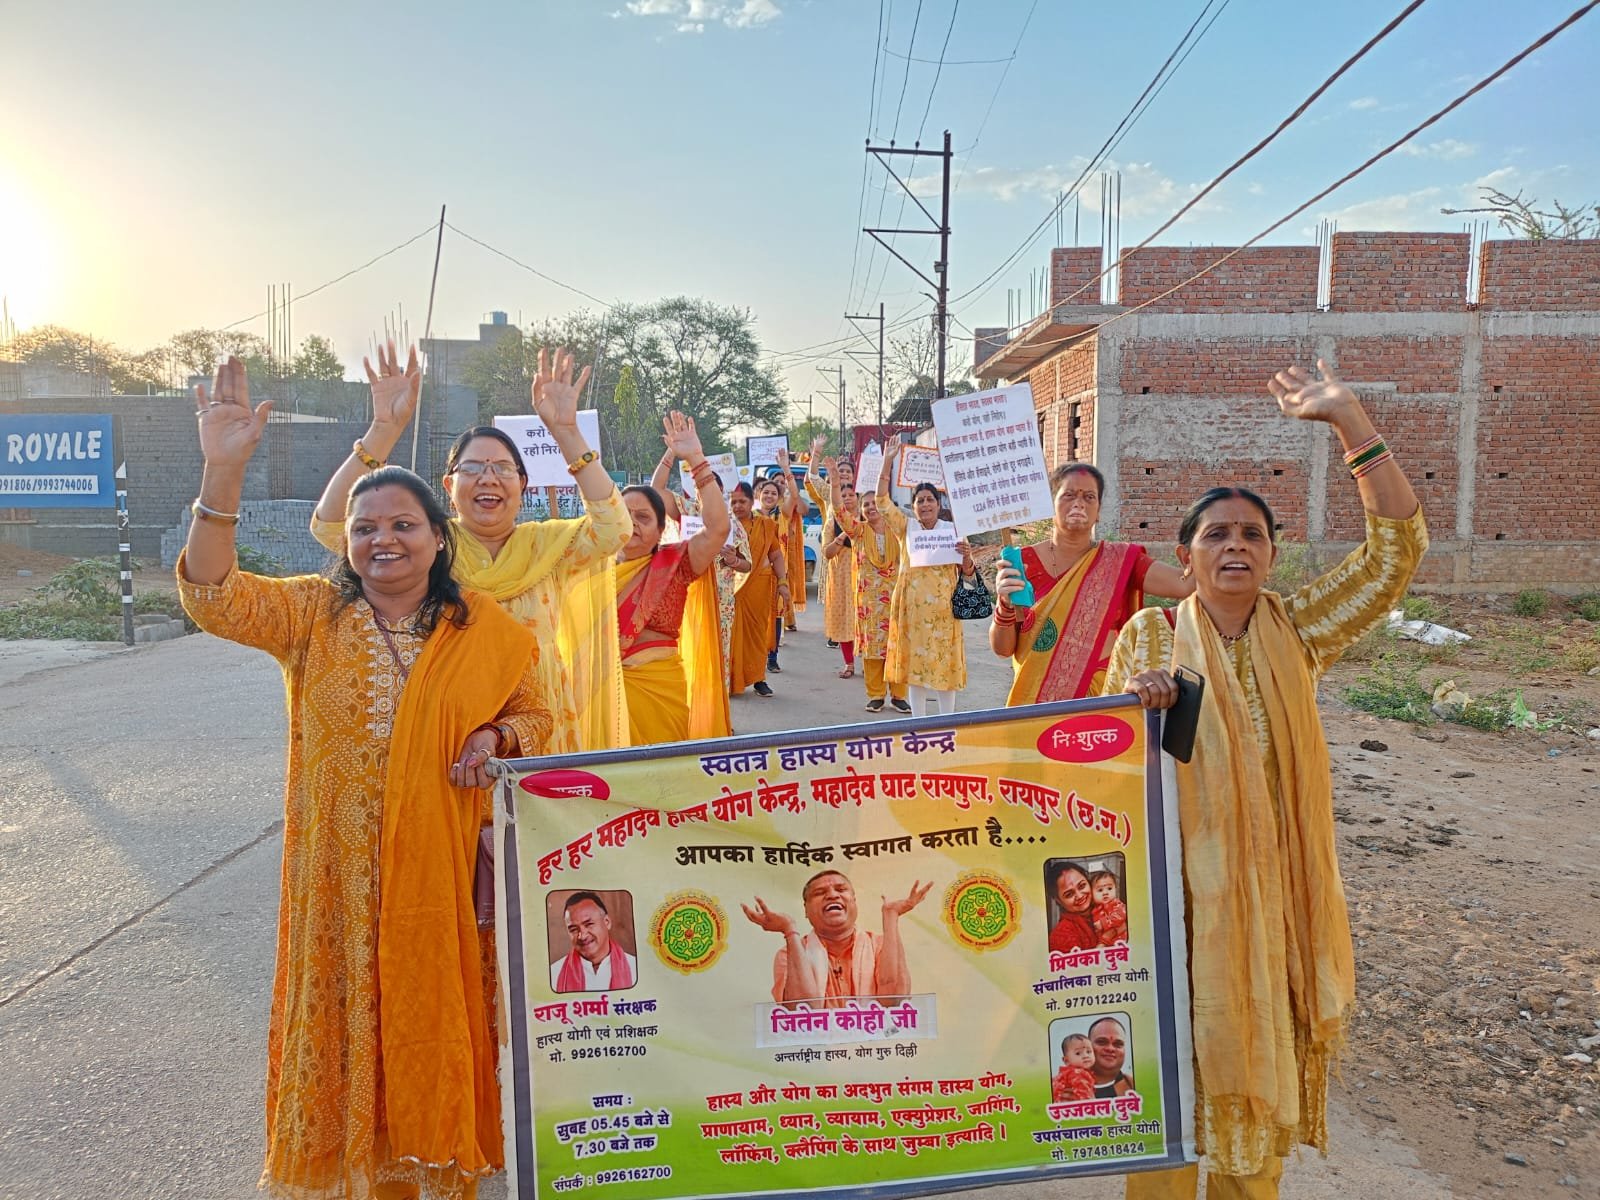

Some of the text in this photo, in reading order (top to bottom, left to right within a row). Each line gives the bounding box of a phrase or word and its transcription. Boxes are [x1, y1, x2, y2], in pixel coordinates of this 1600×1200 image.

[526, 426, 545, 438] करो
[7, 431, 102, 464] ROYALE
[523, 443, 560, 456] रहो निर
[778, 744, 837, 771] हास्य
[846, 737, 892, 760] योग
[902, 732, 955, 754] केन्द्र
[538, 849, 563, 884] हर
[567, 833, 593, 869] हर
[597, 807, 659, 847] महादेव
[713, 787, 752, 822] योग
[758, 778, 806, 813] केन्द्र,
[811, 766, 875, 808] महादेव
[880, 773, 916, 798] घाट
[921, 773, 993, 808] रायपुरा,
[999, 779, 1060, 823] रायपुर
[675, 845, 753, 866] आपका
[762, 842, 833, 867] हार्दिक
[841, 835, 912, 859] स्वागत
[920, 826, 978, 849] करता
[1049, 942, 1129, 972] प्रियंका दुबे
[1033, 968, 1149, 995] संचालिका हास्य योगी
[534, 995, 657, 1024] राजू शर्मा संरक्षक
[1046, 992, 1137, 1012] मो. 9770122240
[772, 1002, 917, 1034] जितेन कोही जी
[536, 1024, 658, 1048] हास्य योगी एवं प्रशिक्षक
[550, 1046, 646, 1062] मो. 9926162700
[825, 1049, 851, 1061] हास्य,
[855, 1046, 872, 1057] योग
[876, 1047, 892, 1060] गुरु
[896, 1043, 918, 1057] दिल्ली
[593, 1095, 623, 1108] समय
[706, 1072, 1013, 1111] हास्य और योग का अदभुत संगम हास्य योग,
[700, 1094, 1021, 1138] प्राणायाम, ध्यान, व्यायाम, एक्युप्रेशर, जागिंग,
[1049, 1092, 1141, 1120] उज्जवल दुबे
[557, 1111, 669, 1141] सुबह 05.45 बजे से
[1033, 1119, 1160, 1144] उपसंचालक हास्य योगी
[576, 1135, 655, 1156] 7.30 बजे तक
[720, 1144, 779, 1164] लॉफिंग,
[785, 1132, 837, 1159] क्लैपिंग
[842, 1134, 859, 1153] के
[864, 1137, 896, 1153] साथ
[902, 1134, 941, 1156] जुम्बा
[946, 1123, 993, 1149] इत्यादि
[1052, 1142, 1144, 1160] मो. 7974818424
[554, 1176, 583, 1191] संपर्क
[597, 1167, 671, 1183] 9926162700
